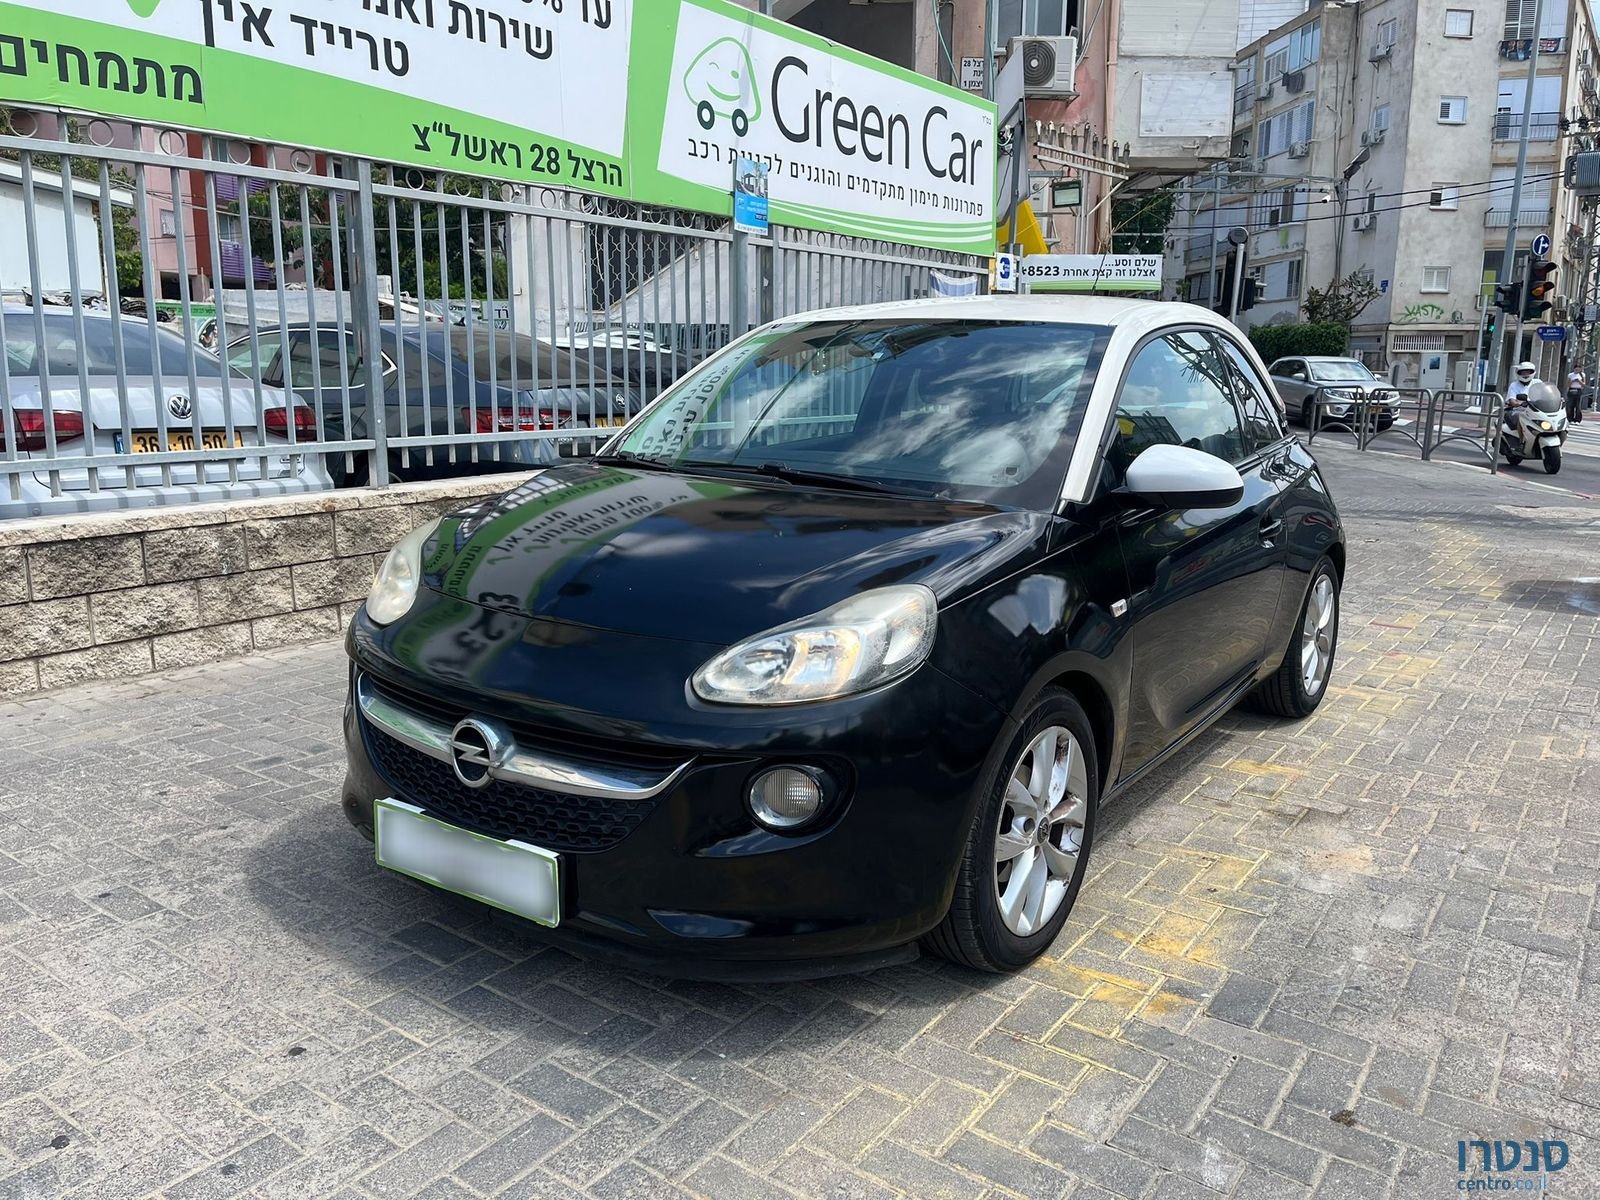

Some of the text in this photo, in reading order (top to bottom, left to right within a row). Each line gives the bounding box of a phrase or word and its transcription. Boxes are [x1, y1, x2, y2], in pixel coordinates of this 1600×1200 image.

[202, 0, 409, 77] טרייד אין
[448, 2, 553, 60] שירות
[0, 34, 204, 104] מתמחים
[771, 55, 983, 186] Green Car
[530, 143, 561, 175] 28
[688, 138, 720, 162] רכב
[567, 149, 623, 187] הרצל
[790, 161, 841, 187] והוגנים
[847, 174, 905, 201] מתקדמים
[909, 187, 939, 207] מימון
[943, 195, 983, 217] פתרונות
[1062, 268, 1089, 277] אחרת
[1115, 268, 1126, 277] זה
[1128, 268, 1156, 277] אצלנו
[1134, 257, 1157, 267] שלם
